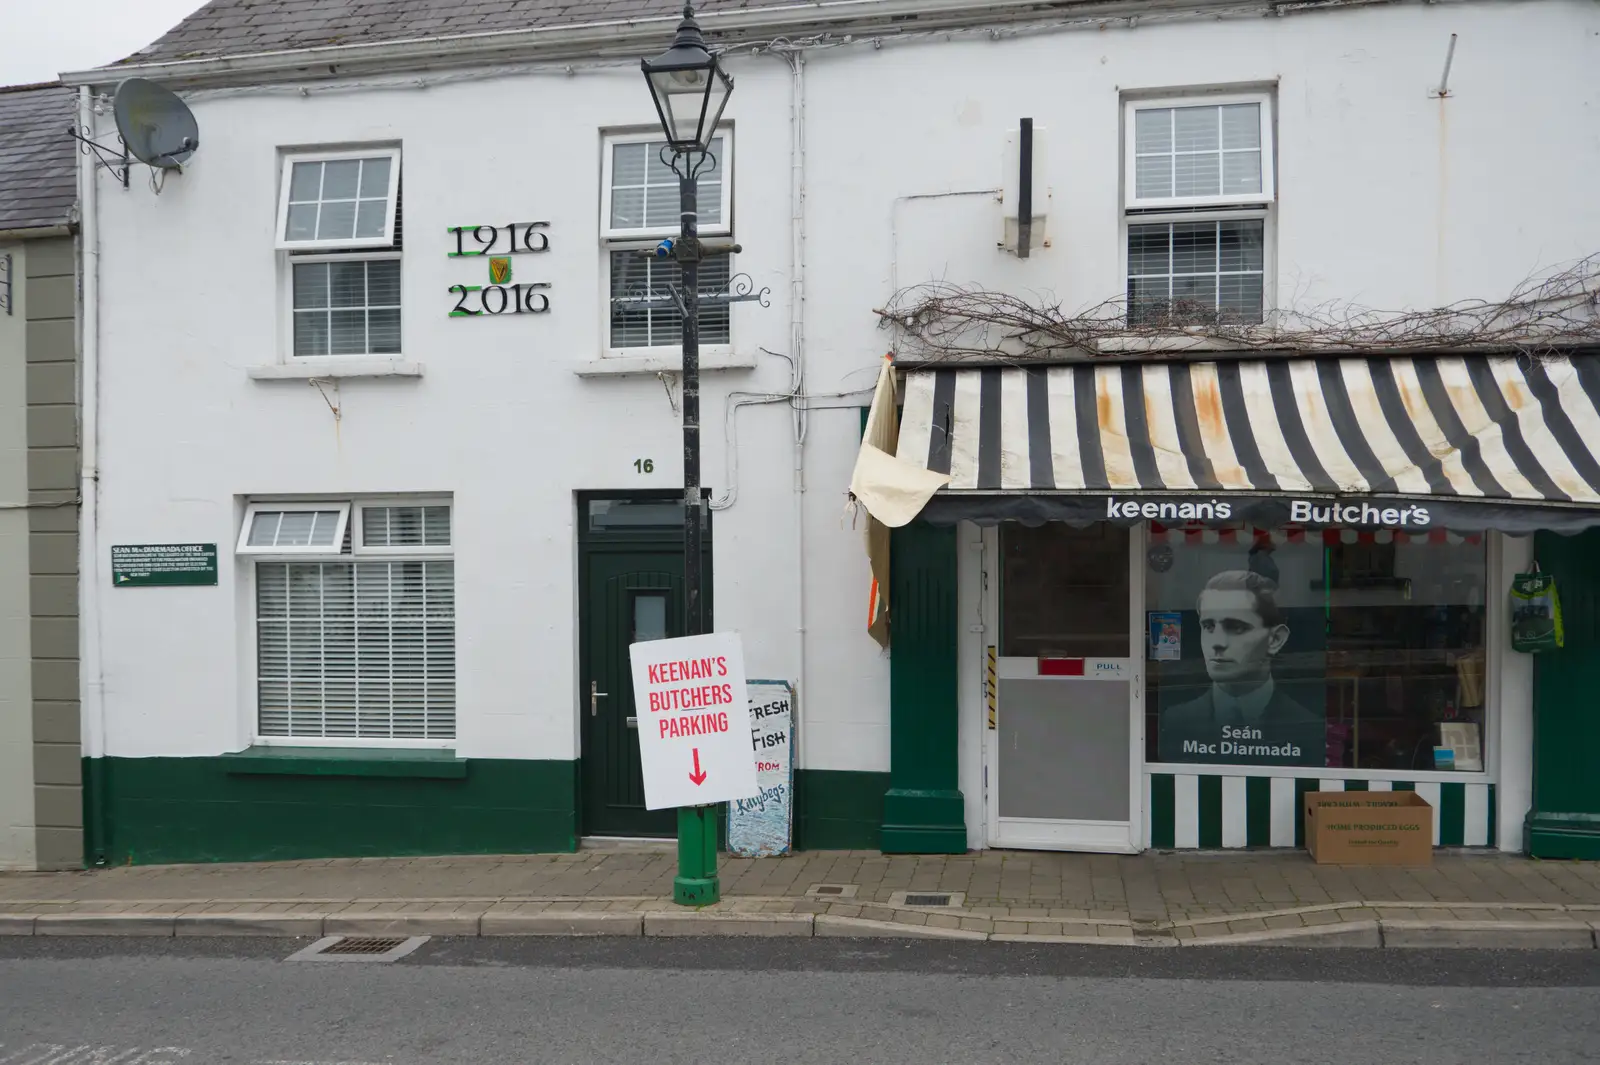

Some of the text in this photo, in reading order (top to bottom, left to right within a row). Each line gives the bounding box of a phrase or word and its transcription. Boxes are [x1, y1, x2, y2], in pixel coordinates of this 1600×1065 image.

[449, 221, 550, 255] 1916
[447, 283, 550, 315] 2016
[633, 458, 654, 474] 16
[1107, 497, 1431, 525] keenan's Butcher's
[648, 656, 728, 684] KEENAN'S
[649, 684, 733, 712] BUTCHERS
[659, 712, 729, 739] PARKING
[1222, 725, 1262, 740] Seán
[1183, 739, 1301, 756] Mac Diarmada
[755, 761, 780, 772] ROM
